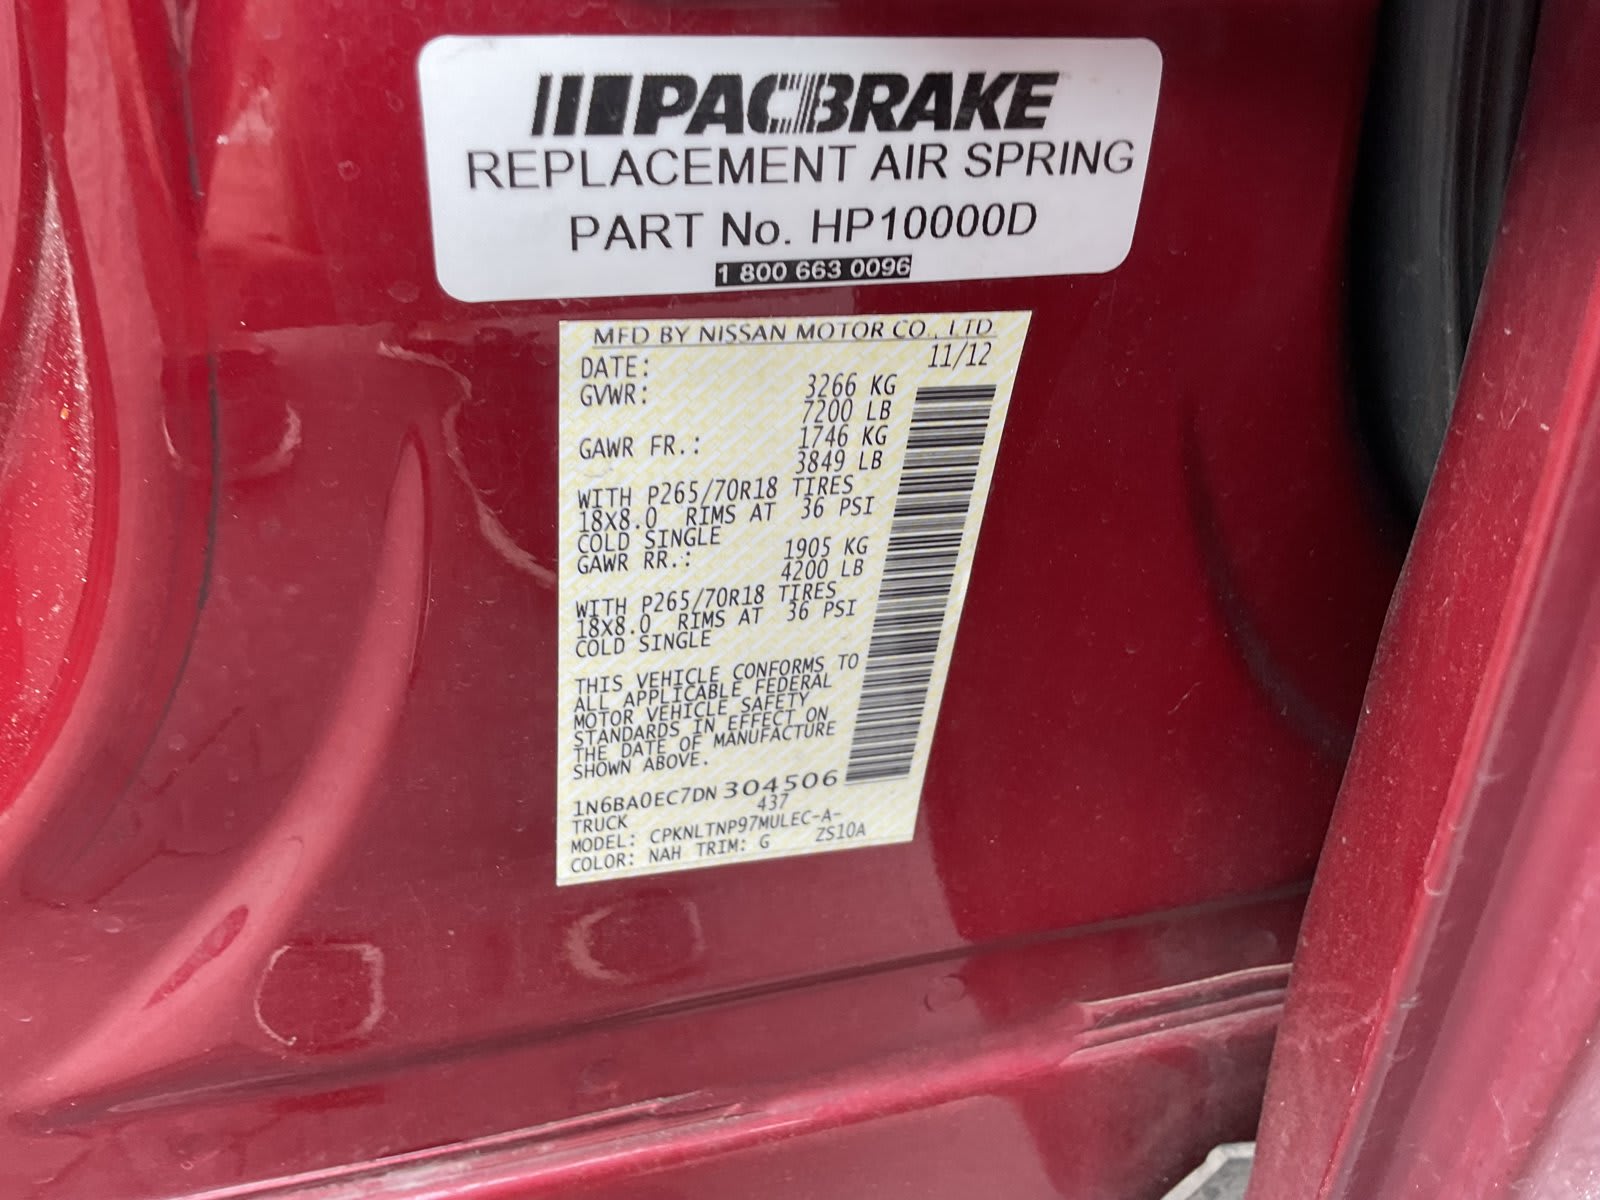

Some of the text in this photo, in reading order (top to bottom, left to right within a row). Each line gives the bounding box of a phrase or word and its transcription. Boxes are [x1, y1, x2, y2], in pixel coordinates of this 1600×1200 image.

[631, 70, 1061, 135] PACBRAKE
[466, 139, 1136, 189] REPLACEMENT AIR SPRING
[569, 203, 1037, 250] PART No. HP10000D
[718, 257, 911, 282] 1 800 663 0096
[594, 326, 650, 345] MFD
[660, 326, 689, 343] BY
[699, 324, 786, 343] NISSAN
[797, 322, 884, 340] MOTOR
[581, 343, 990, 379] DATE: 11/12
[580, 374, 897, 406] GVWR: 3266 KG
[801, 399, 891, 424] 7200 LB
[579, 425, 888, 460] GAWR FR.: 1746 KG
[795, 450, 882, 473] 3849 LB
[577, 476, 854, 509] WITH P265/70R18 TIRES
[579, 496, 876, 533] 18X8.0 RIMS AT 36 PSI
[577, 537, 869, 574] GAWR RR.: 1905 KG
[578, 526, 721, 553] COLD SINGLE
[781, 561, 864, 581] 4200 LB
[575, 581, 837, 619] WITH P265/70R18 TIRES
[577, 600, 858, 639] 18X8.0 RIMS AT 36 PSI
[576, 631, 712, 658] COLD SINGLE
[574, 673, 833, 712] ALL APPLICABLE FEDERAL
[575, 653, 859, 695] THIS VEHICLE CONFORMS TO
[574, 692, 809, 729] MOTOR VEHICLE SAFETY
[574, 707, 828, 747] STANDARDS IN EFFECT ON
[575, 721, 835, 763] THE DATE OF MANUFACTURE
[573, 752, 708, 780] SHOWN ABOVE.
[573, 769, 838, 816] 1N6BA0EC7DN 304506
[571, 809, 843, 854] MODEL: CPKNLTNP97MULEC-A-
[573, 794, 789, 834] TRUCK 437
[571, 823, 866, 873] COLOR: NAH TRIM: G ZS10A
